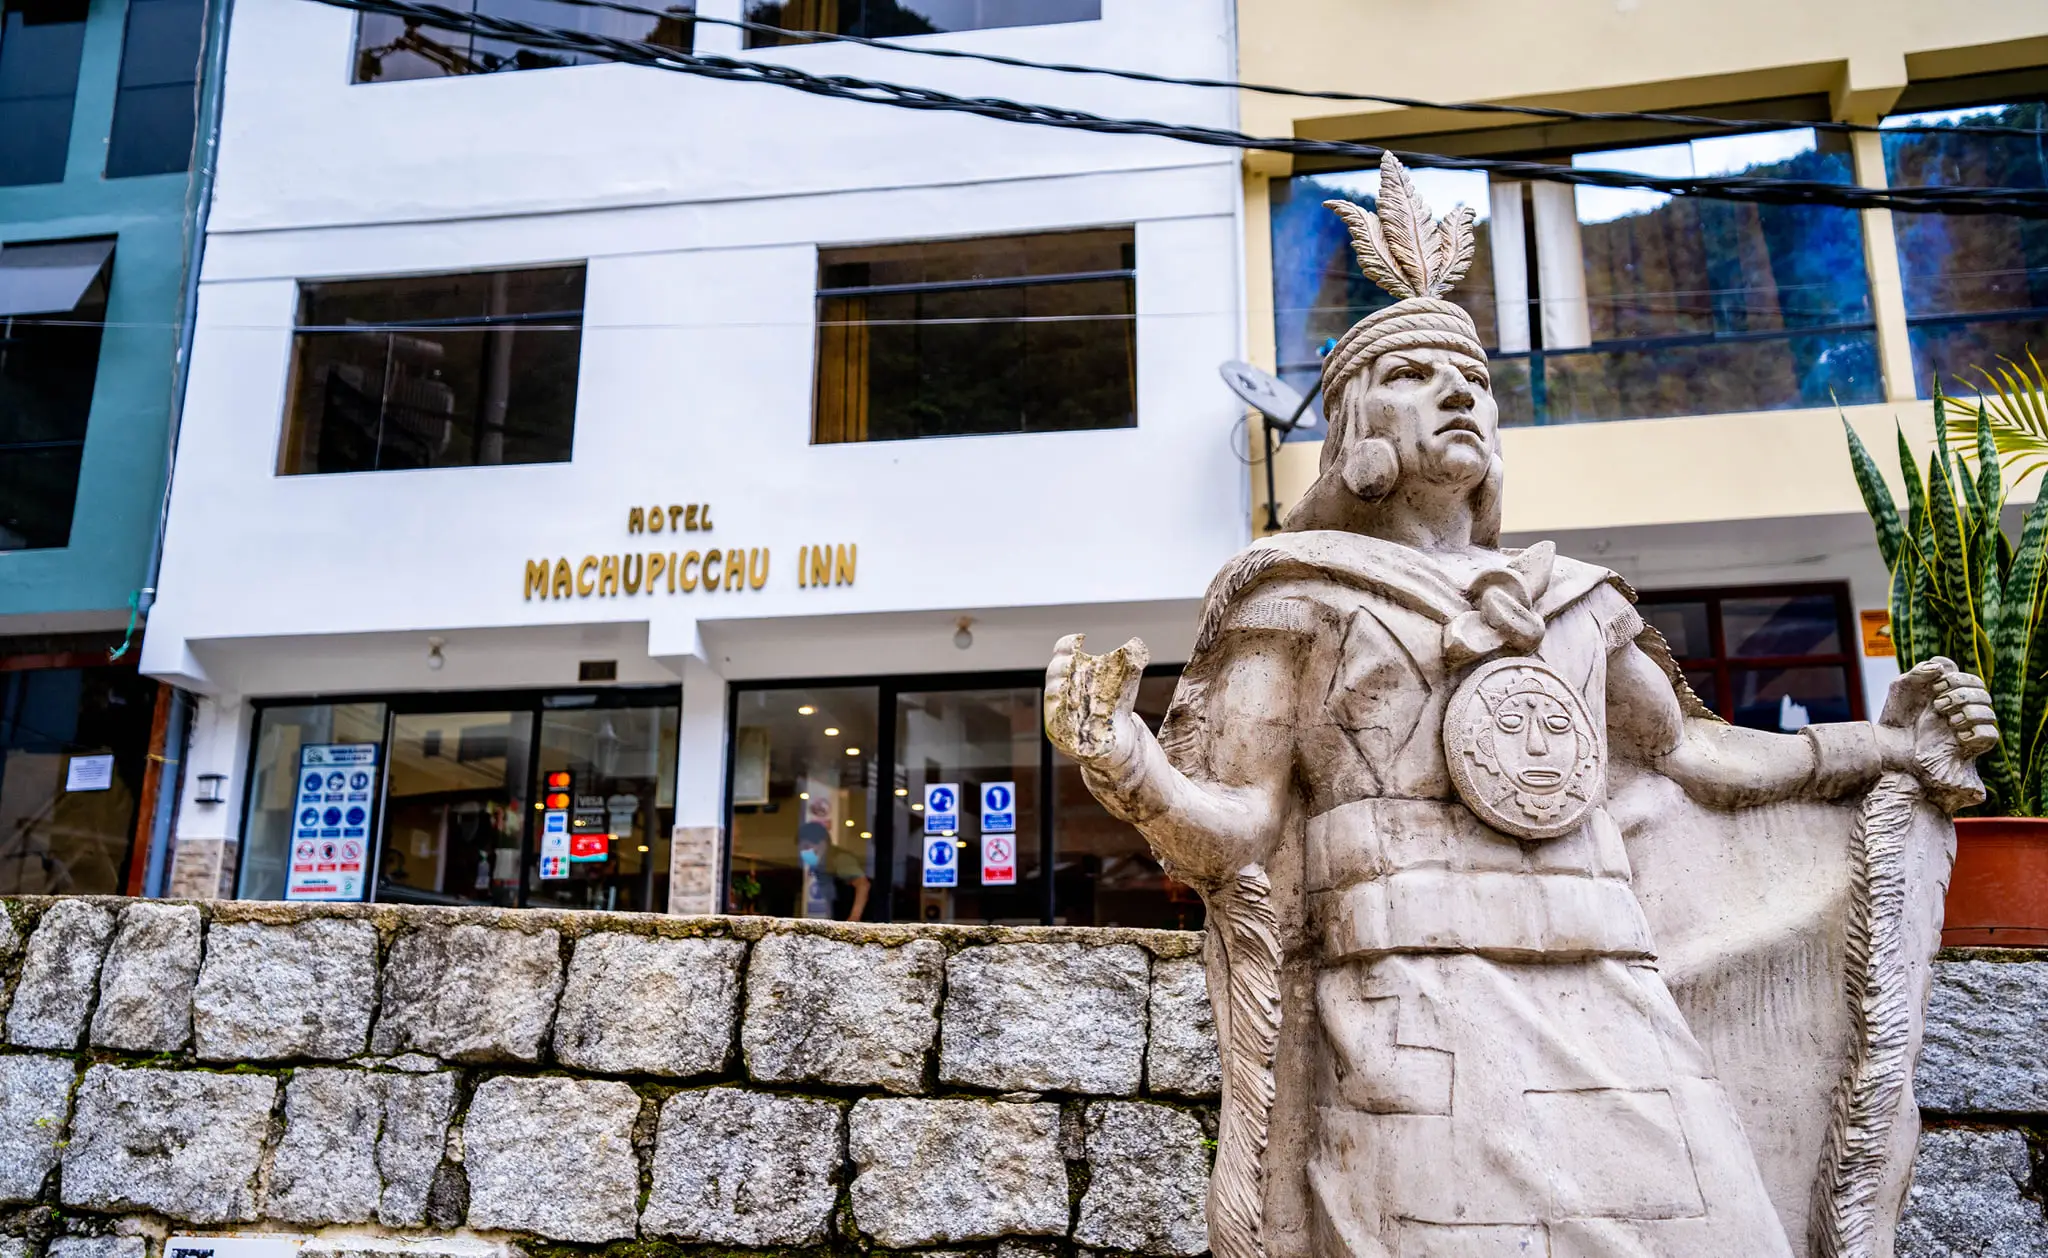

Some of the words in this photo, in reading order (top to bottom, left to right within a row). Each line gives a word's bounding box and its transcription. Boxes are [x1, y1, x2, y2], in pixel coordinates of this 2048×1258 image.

[628, 504, 713, 533] HOTEL
[524, 547, 770, 599] MACHUPICCHU
[799, 543, 857, 588] INN
[579, 796, 604, 806] VISA
